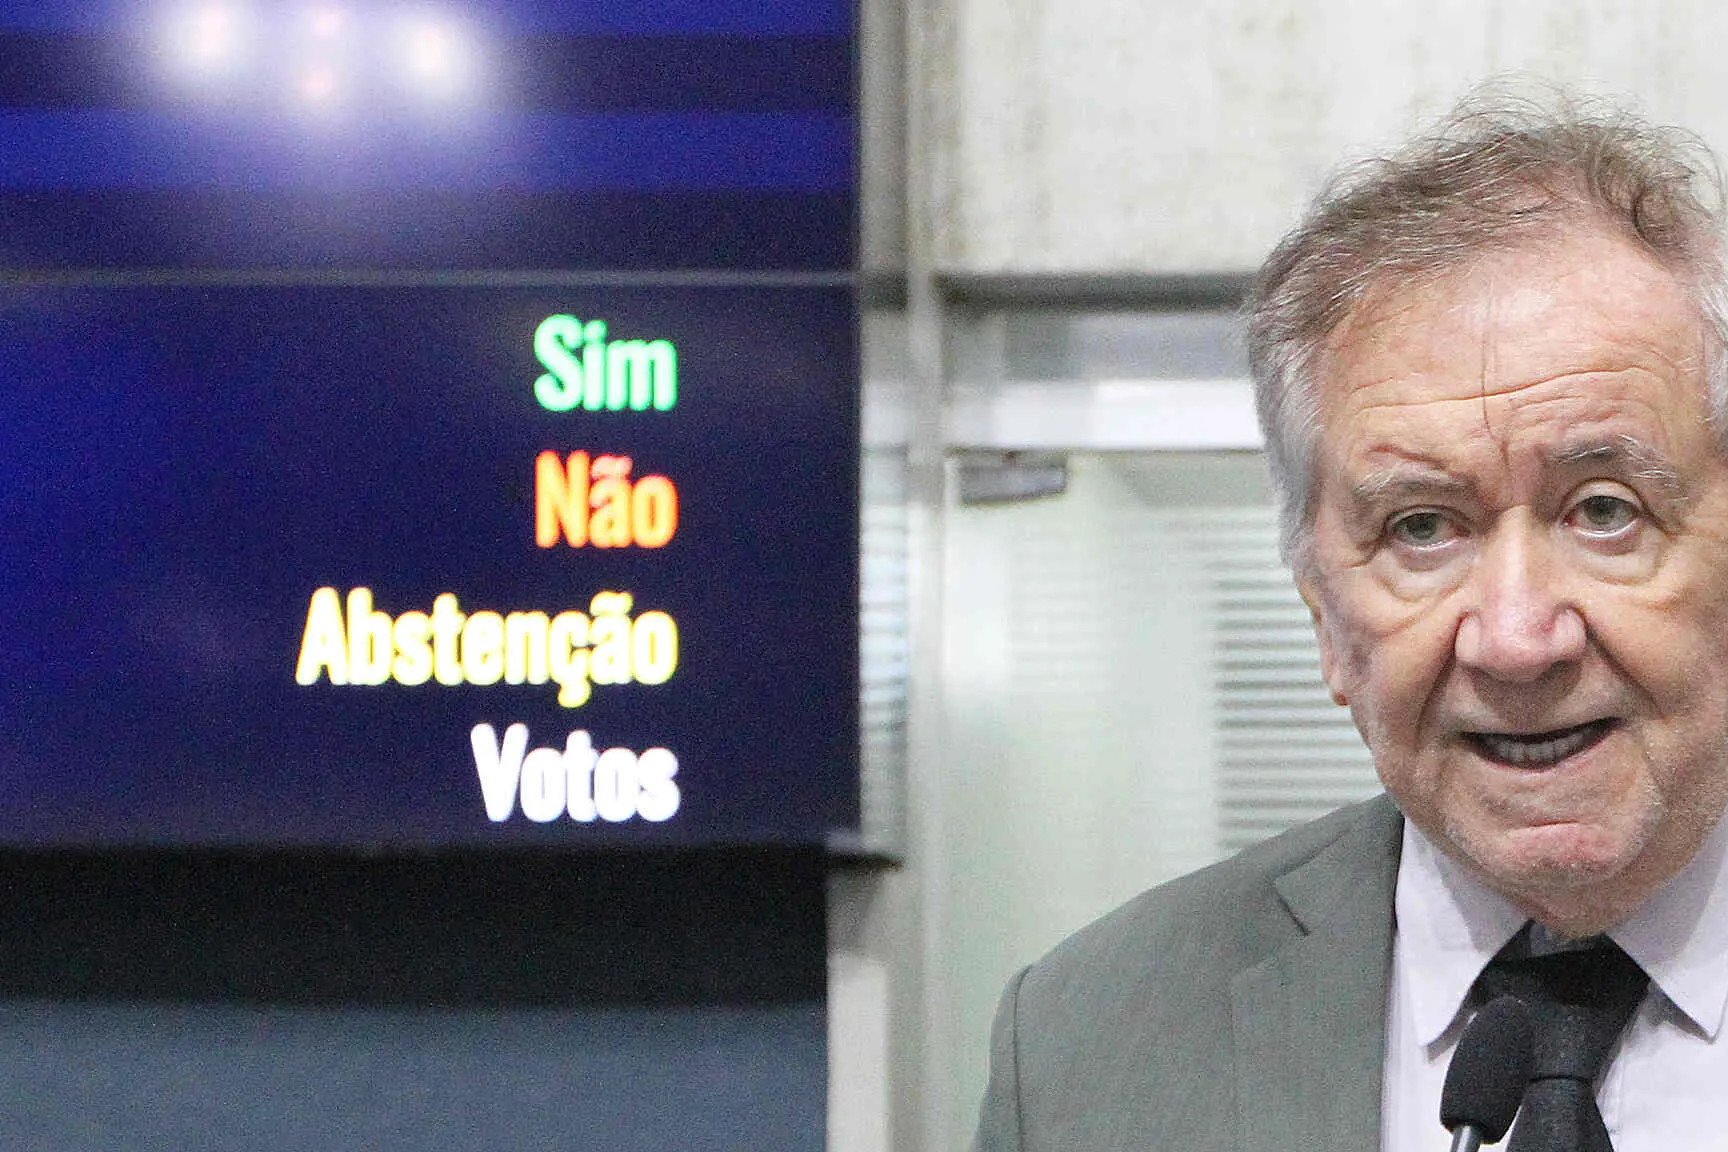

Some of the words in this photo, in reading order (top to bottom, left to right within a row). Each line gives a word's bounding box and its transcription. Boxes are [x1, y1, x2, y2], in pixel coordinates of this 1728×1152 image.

[532, 313, 679, 413] Sim
[534, 449, 680, 550] Não
[295, 586, 680, 708] Abstenção
[471, 722, 682, 824] Votos
